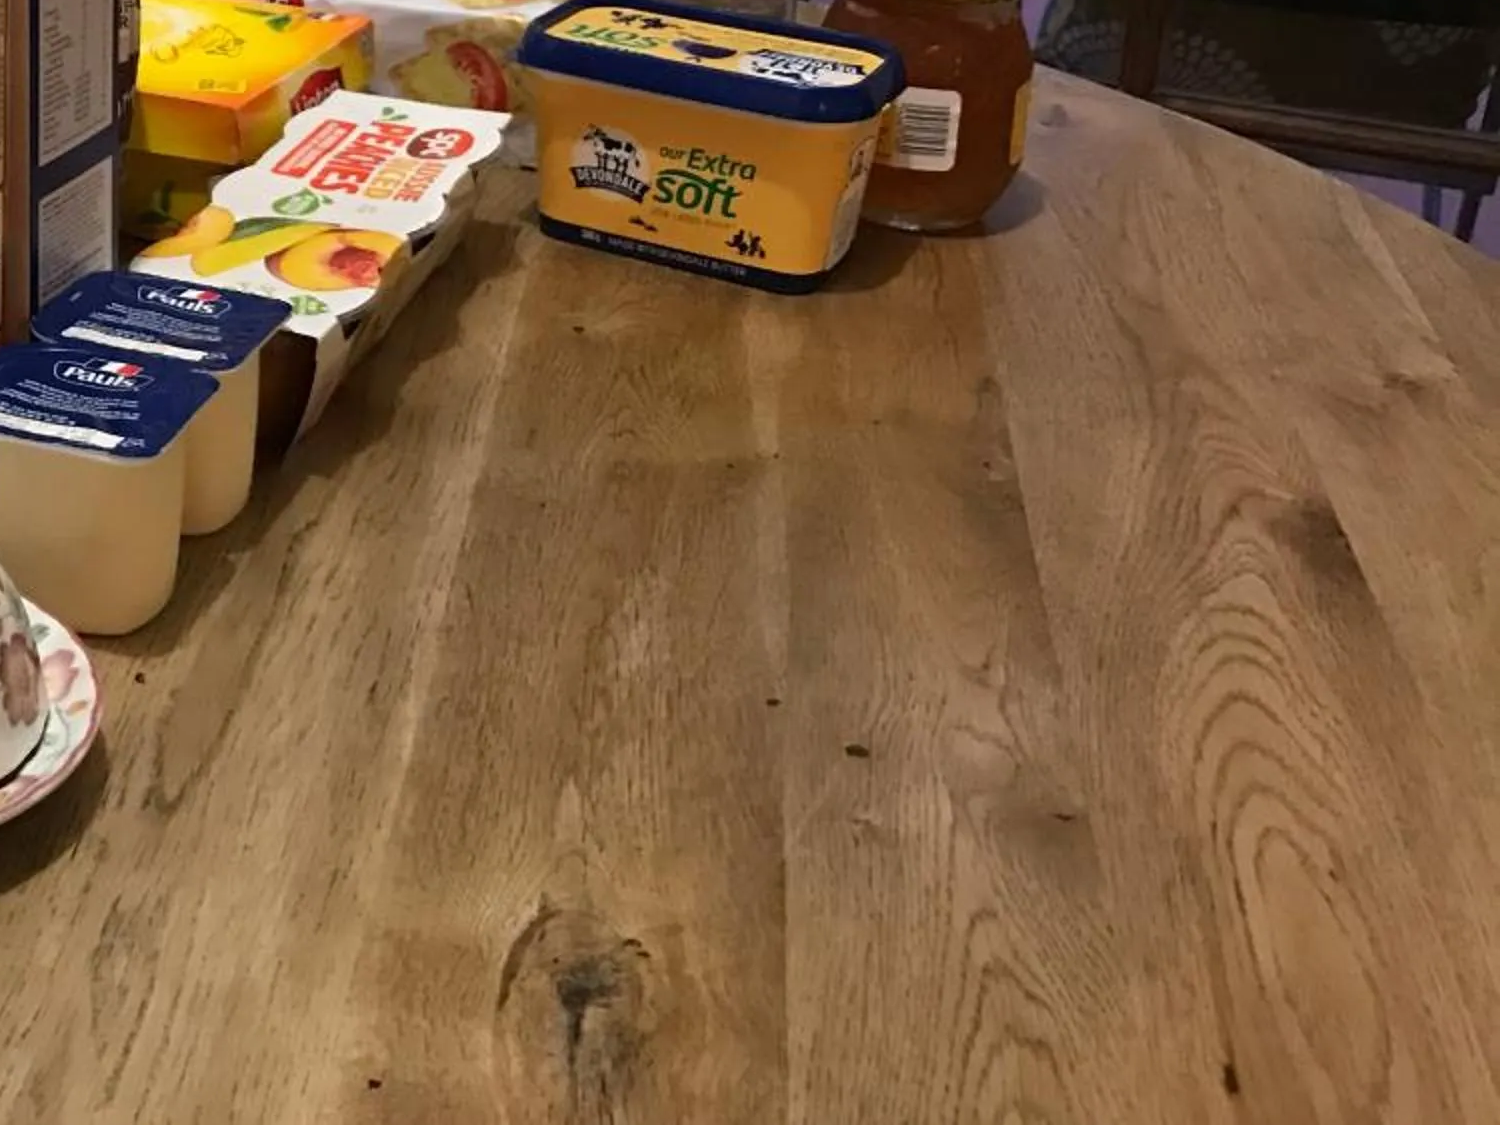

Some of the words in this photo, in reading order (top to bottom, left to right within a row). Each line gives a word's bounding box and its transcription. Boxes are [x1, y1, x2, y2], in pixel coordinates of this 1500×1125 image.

[309, 121, 417, 194] PEACHES
[687, 148, 757, 180] Extra
[577, 167, 643, 195] DEVONDALE
[653, 172, 742, 218] soft
[146, 289, 216, 315] Pauls
[63, 366, 134, 389] Pauls
